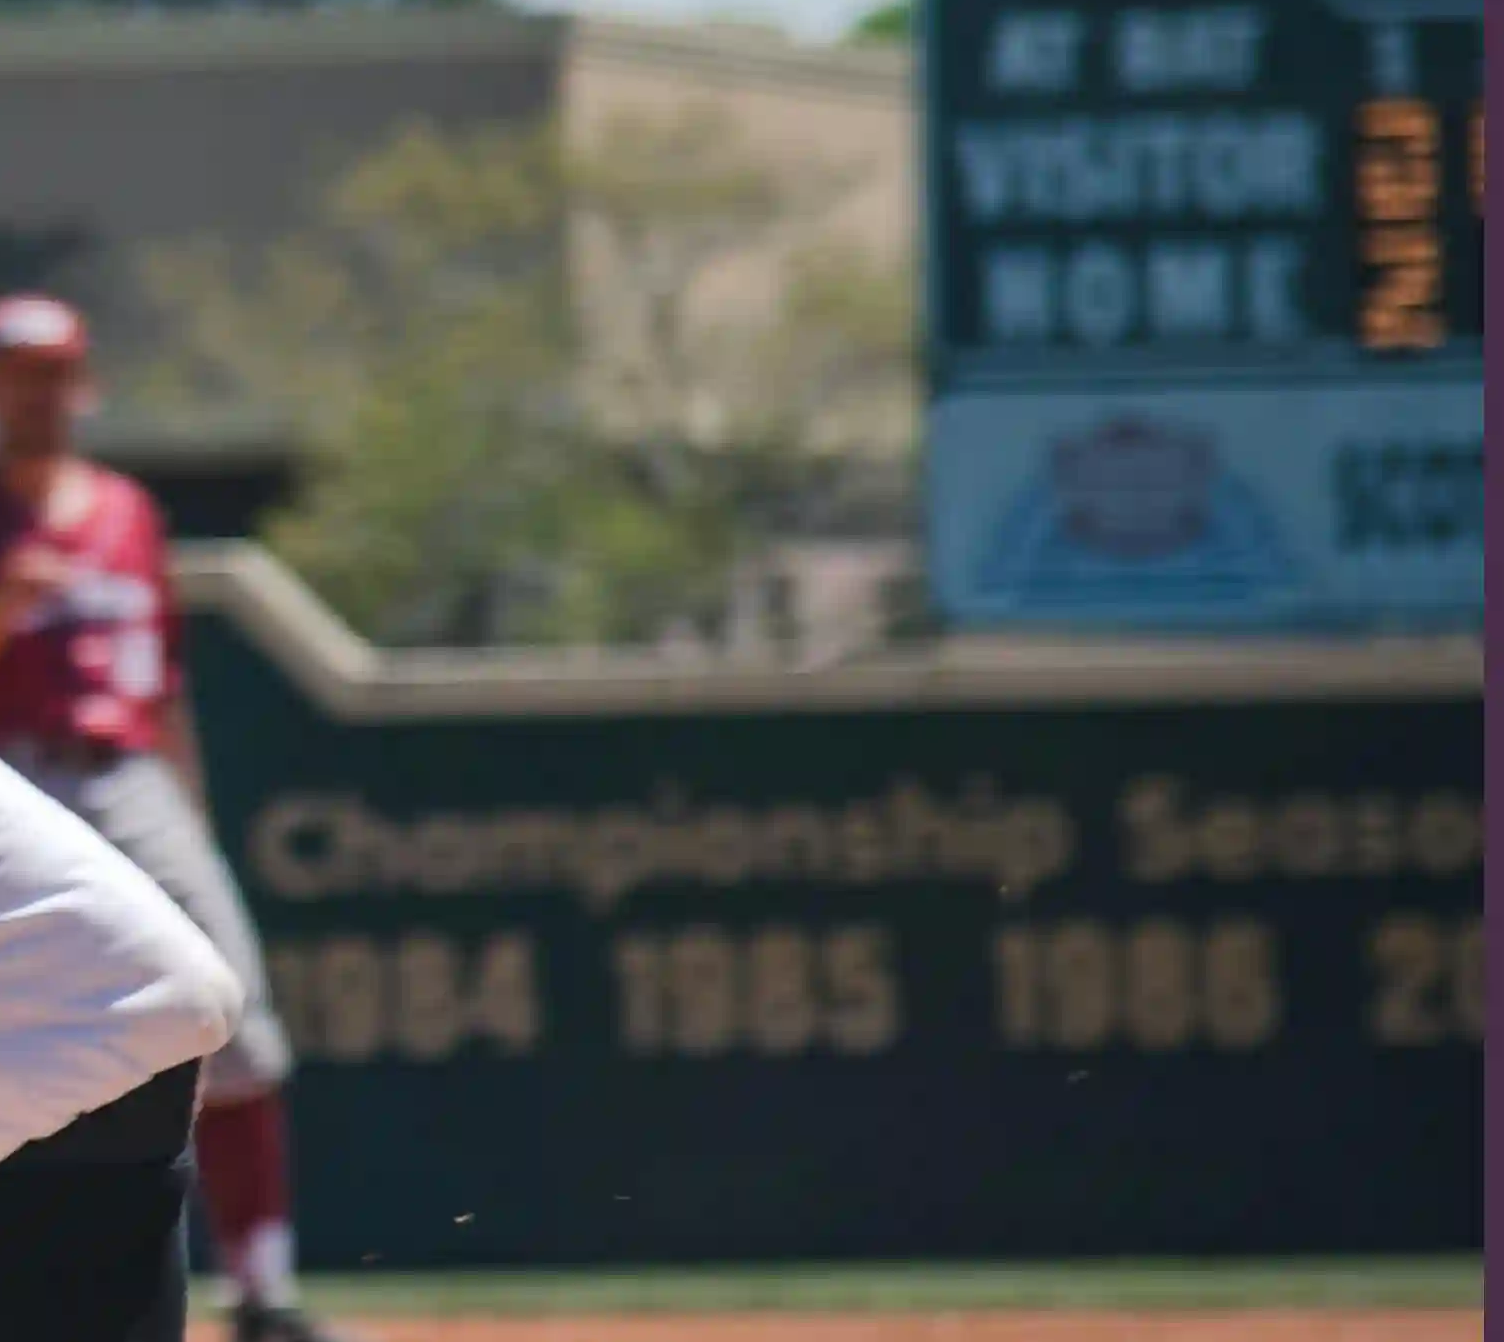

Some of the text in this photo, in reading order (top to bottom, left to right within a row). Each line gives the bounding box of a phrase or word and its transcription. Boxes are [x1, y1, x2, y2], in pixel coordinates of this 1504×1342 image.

[956, 111, 1324, 221] VISITOR
[984, 237, 1306, 343] HOME
[248, 771, 1483, 907] Championship Seaso
[268, 931, 542, 1061] 1984
[614, 925, 898, 1055] 1985
